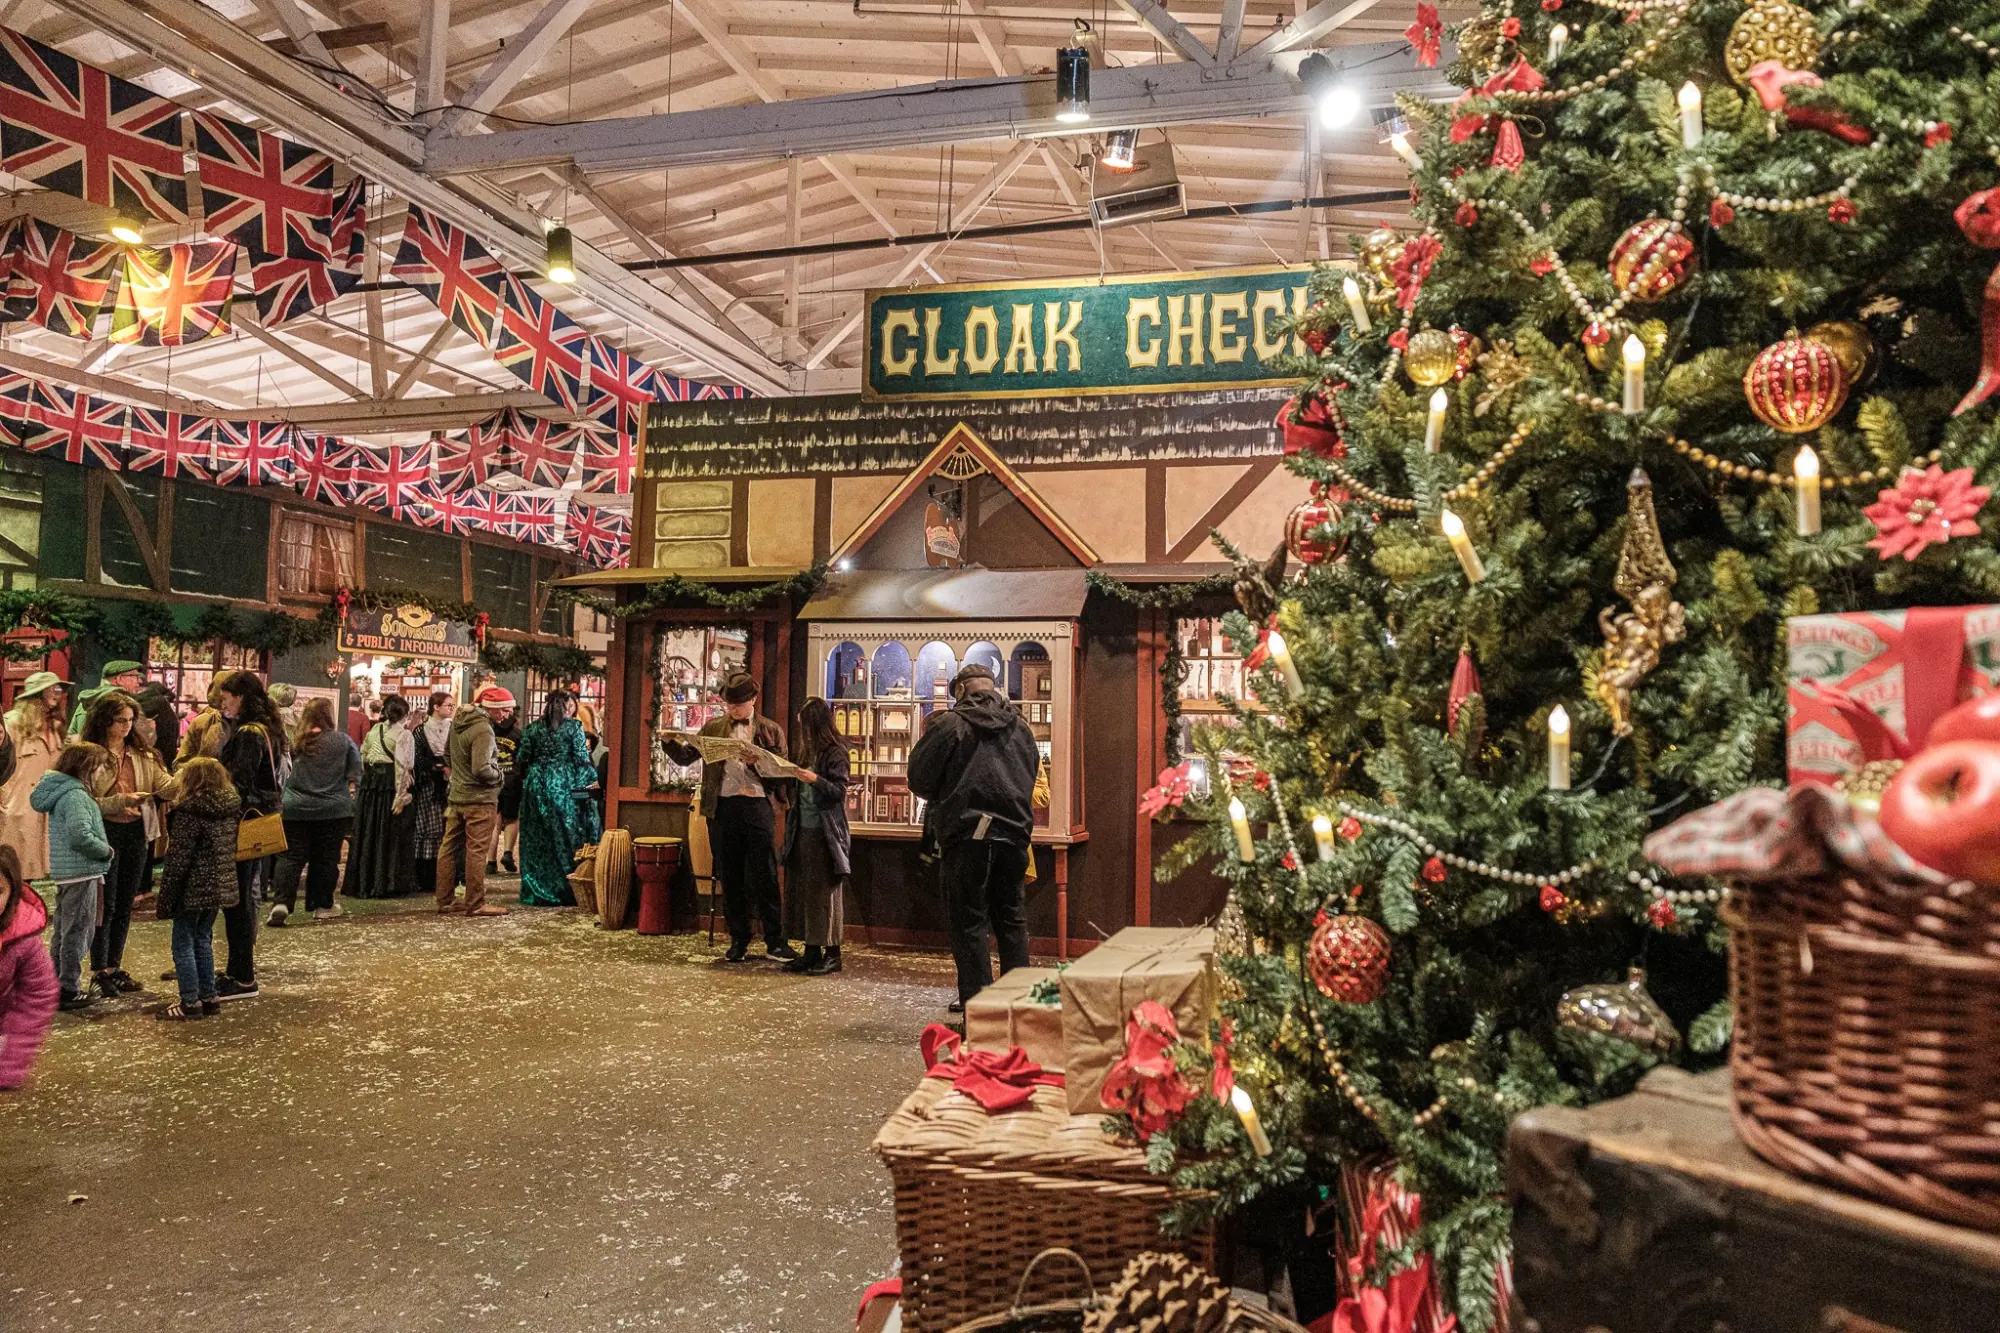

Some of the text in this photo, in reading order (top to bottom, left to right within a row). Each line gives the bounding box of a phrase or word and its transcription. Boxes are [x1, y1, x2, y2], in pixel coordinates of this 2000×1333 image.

[881, 300, 1083, 376] CLOAK
[346, 633, 472, 658] & PUBLIC INFORMATION
